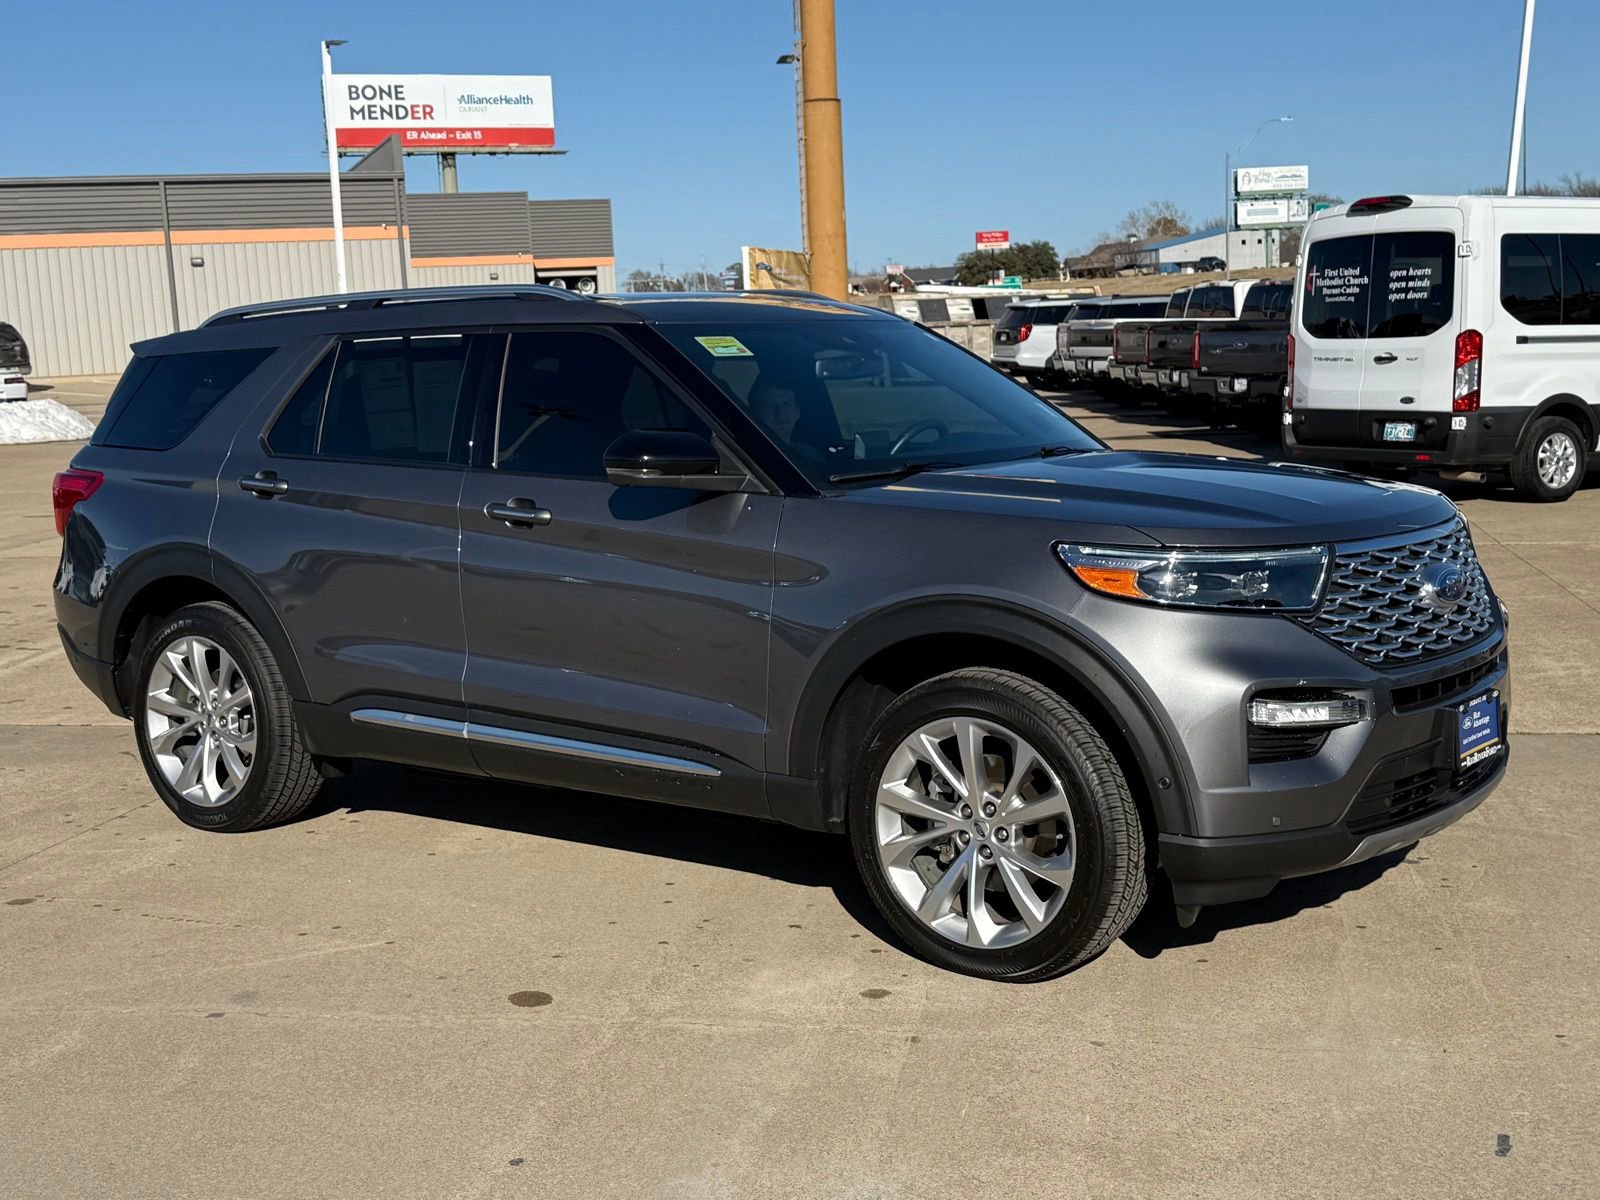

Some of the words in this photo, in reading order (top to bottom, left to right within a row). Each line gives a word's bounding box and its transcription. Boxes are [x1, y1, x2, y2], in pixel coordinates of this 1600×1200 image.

[347, 84, 406, 101] BONE
[457, 94, 534, 105] AllianceHealth
[349, 104, 435, 121] MENDER
[406, 130, 418, 140] ER
[420, 130, 447, 140] Ahead
[456, 130, 473, 140] Exit
[473, 130, 483, 140] 15
[1324, 268, 1339, 277] First
[1339, 266, 1360, 276] United
[1389, 270, 1407, 280] open
[1408, 266, 1432, 276] hearts
[1316, 277, 1344, 287] Methodist
[1345, 275, 1369, 285] Church
[1389, 281, 1407, 291] open
[1407, 277, 1431, 288] minds
[1388, 293, 1406, 303] open
[1406, 289, 1428, 299] doors
